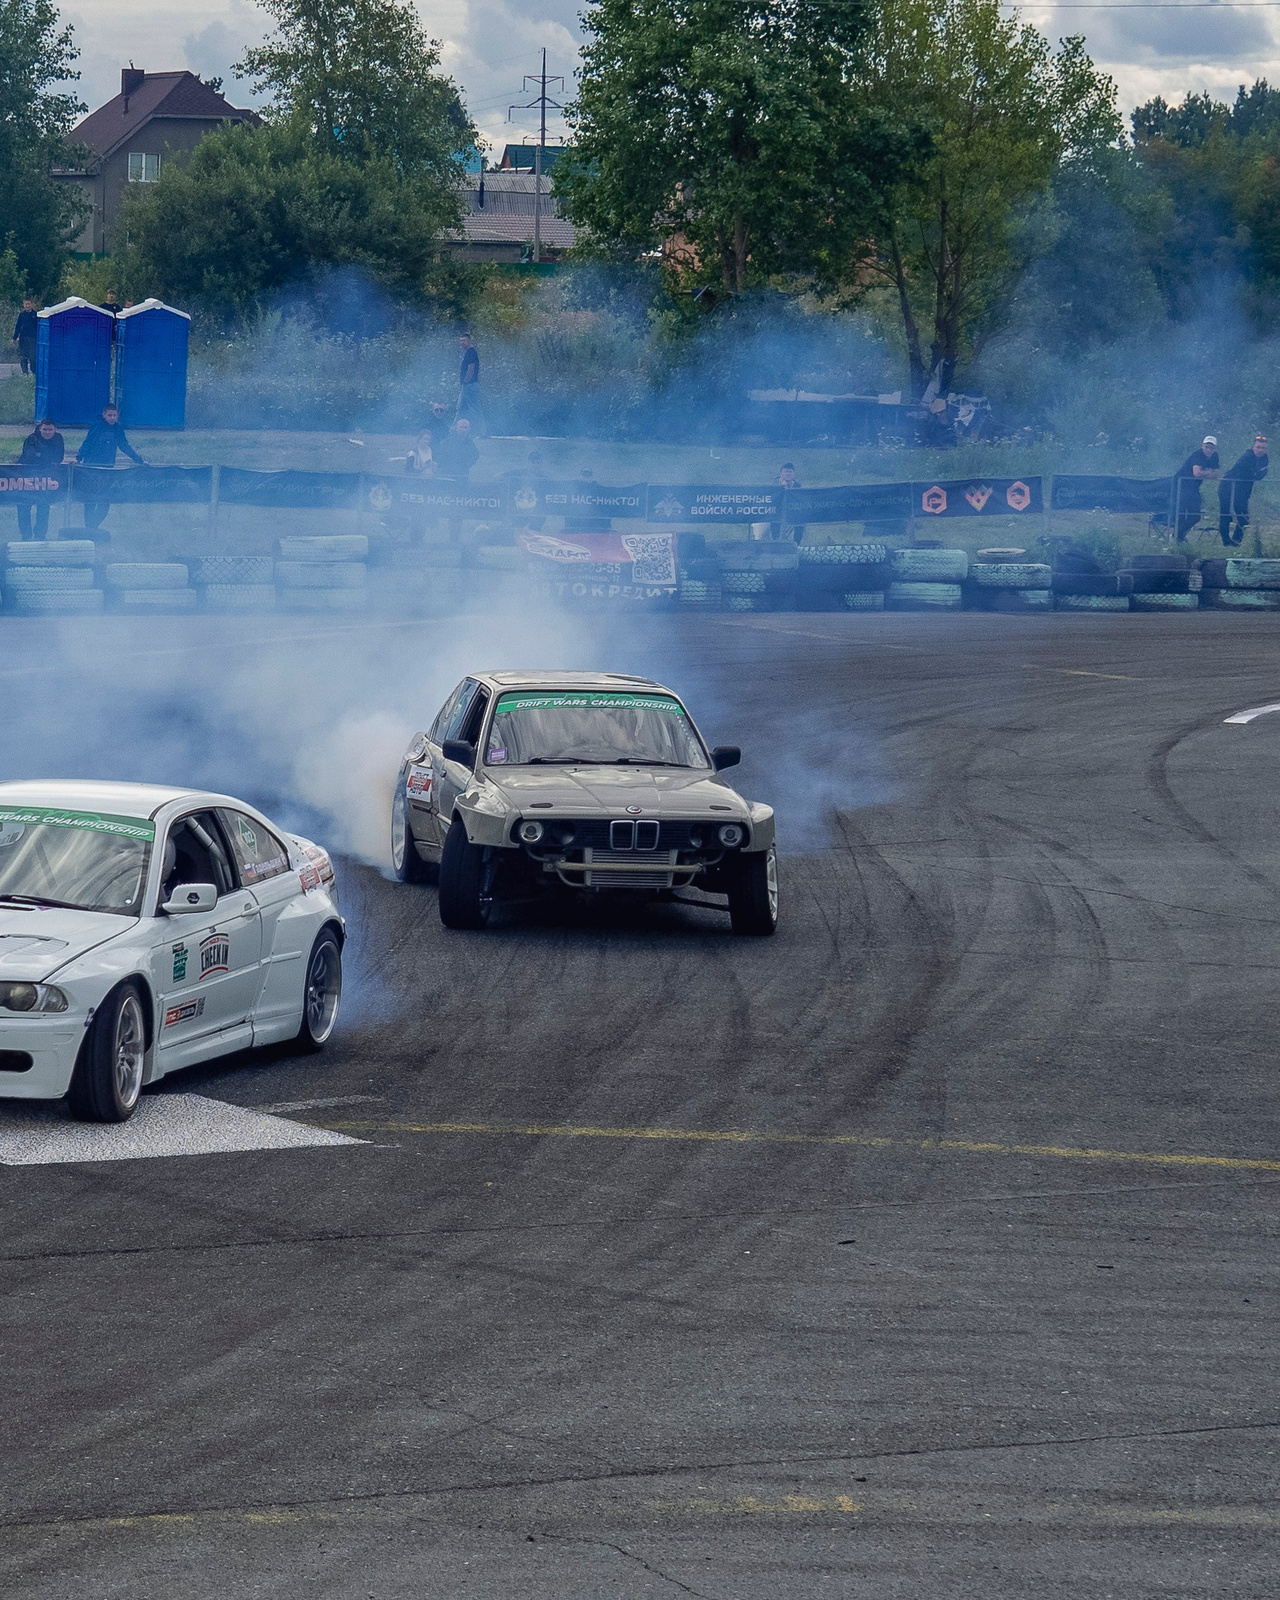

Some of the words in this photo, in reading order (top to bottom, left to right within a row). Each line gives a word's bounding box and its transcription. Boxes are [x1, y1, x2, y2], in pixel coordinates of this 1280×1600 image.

[400, 493, 424, 504] БЕЗ
[545, 494, 567, 504] БЕЗ
[696, 494, 772, 504] ИНЖЕНЕРНЫЕ
[690, 504, 733, 515] ВОЙСКА
[736, 506, 776, 515] РОССИИ
[516, 700, 551, 708] DRIFT
[591, 699, 679, 711] CHAMPIONSHIP
[41, 816, 150, 837] CHAMPIONSHIP
[200, 944, 222, 972] CHECK
[222, 943, 229, 965] IN
